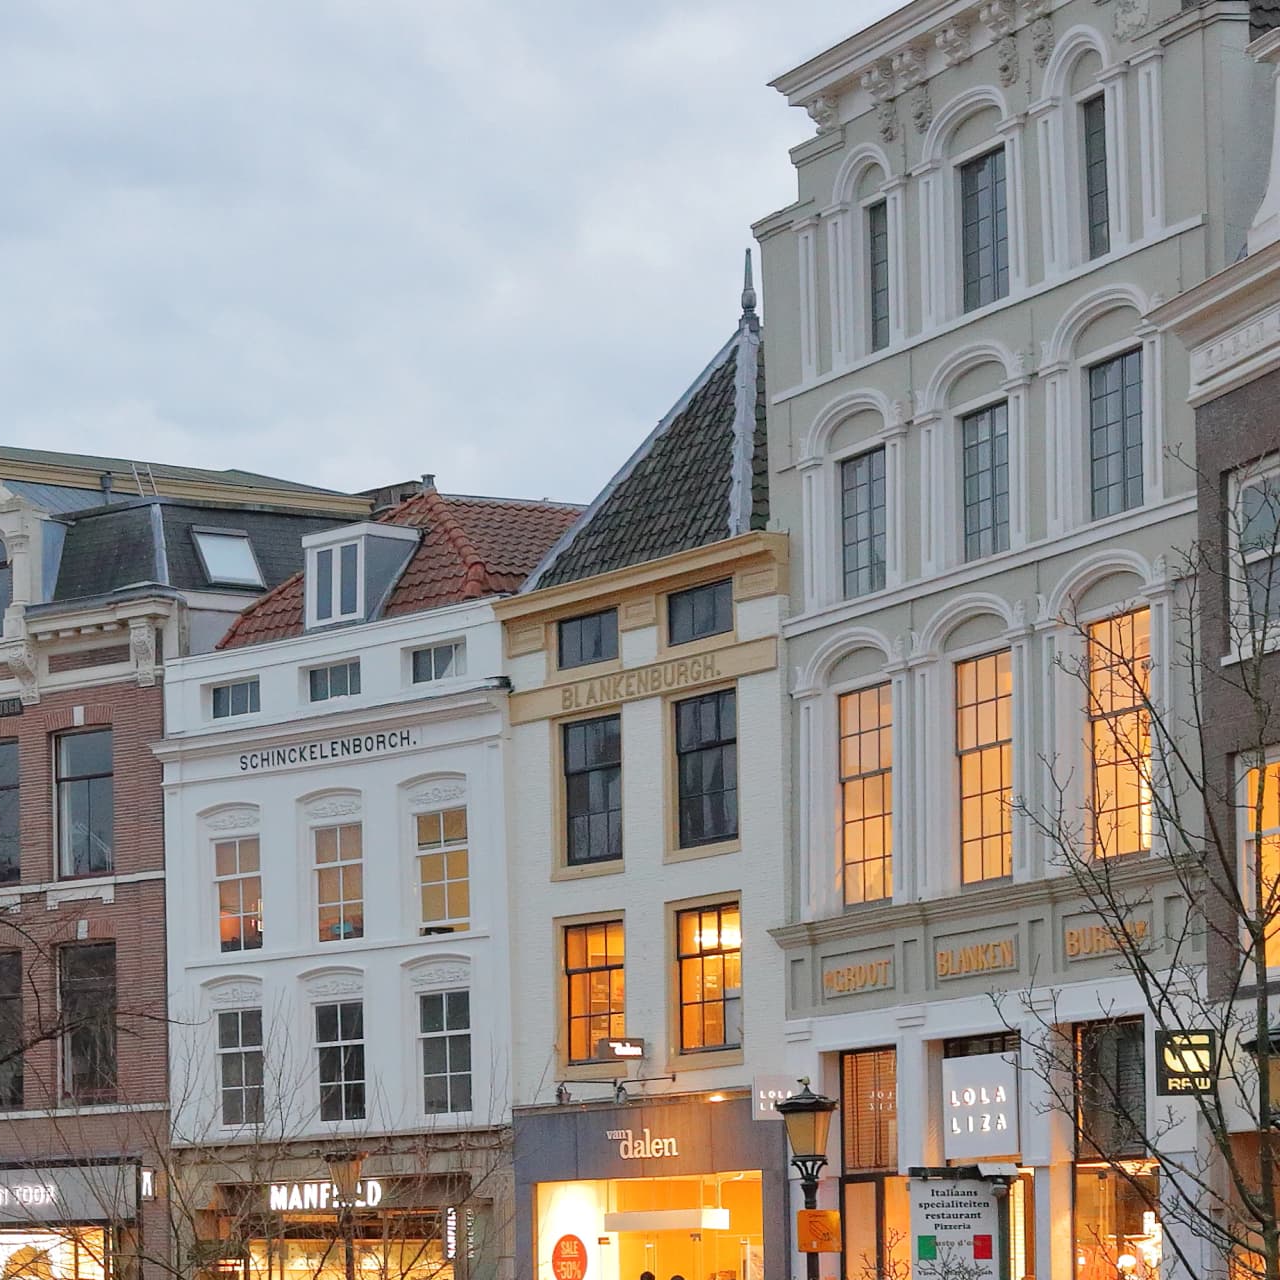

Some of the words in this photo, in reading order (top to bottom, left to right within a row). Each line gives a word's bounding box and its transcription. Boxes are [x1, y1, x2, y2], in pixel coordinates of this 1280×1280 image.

[561, 654, 721, 710] BLANKENBURGH.
[240, 729, 417, 771] SCHINCKELENBORCH.
[950, 1085, 1007, 1107] LOLA
[951, 1113, 1007, 1134] LIZA
[606, 1129, 627, 1140] van
[620, 1128, 679, 1159] dalen
[931, 1188, 978, 1197] Italiaans
[918, 1200, 990, 1211] specialiteiten
[925, 1211, 982, 1220] restaurant
[934, 1222, 971, 1230] Pizzeria
